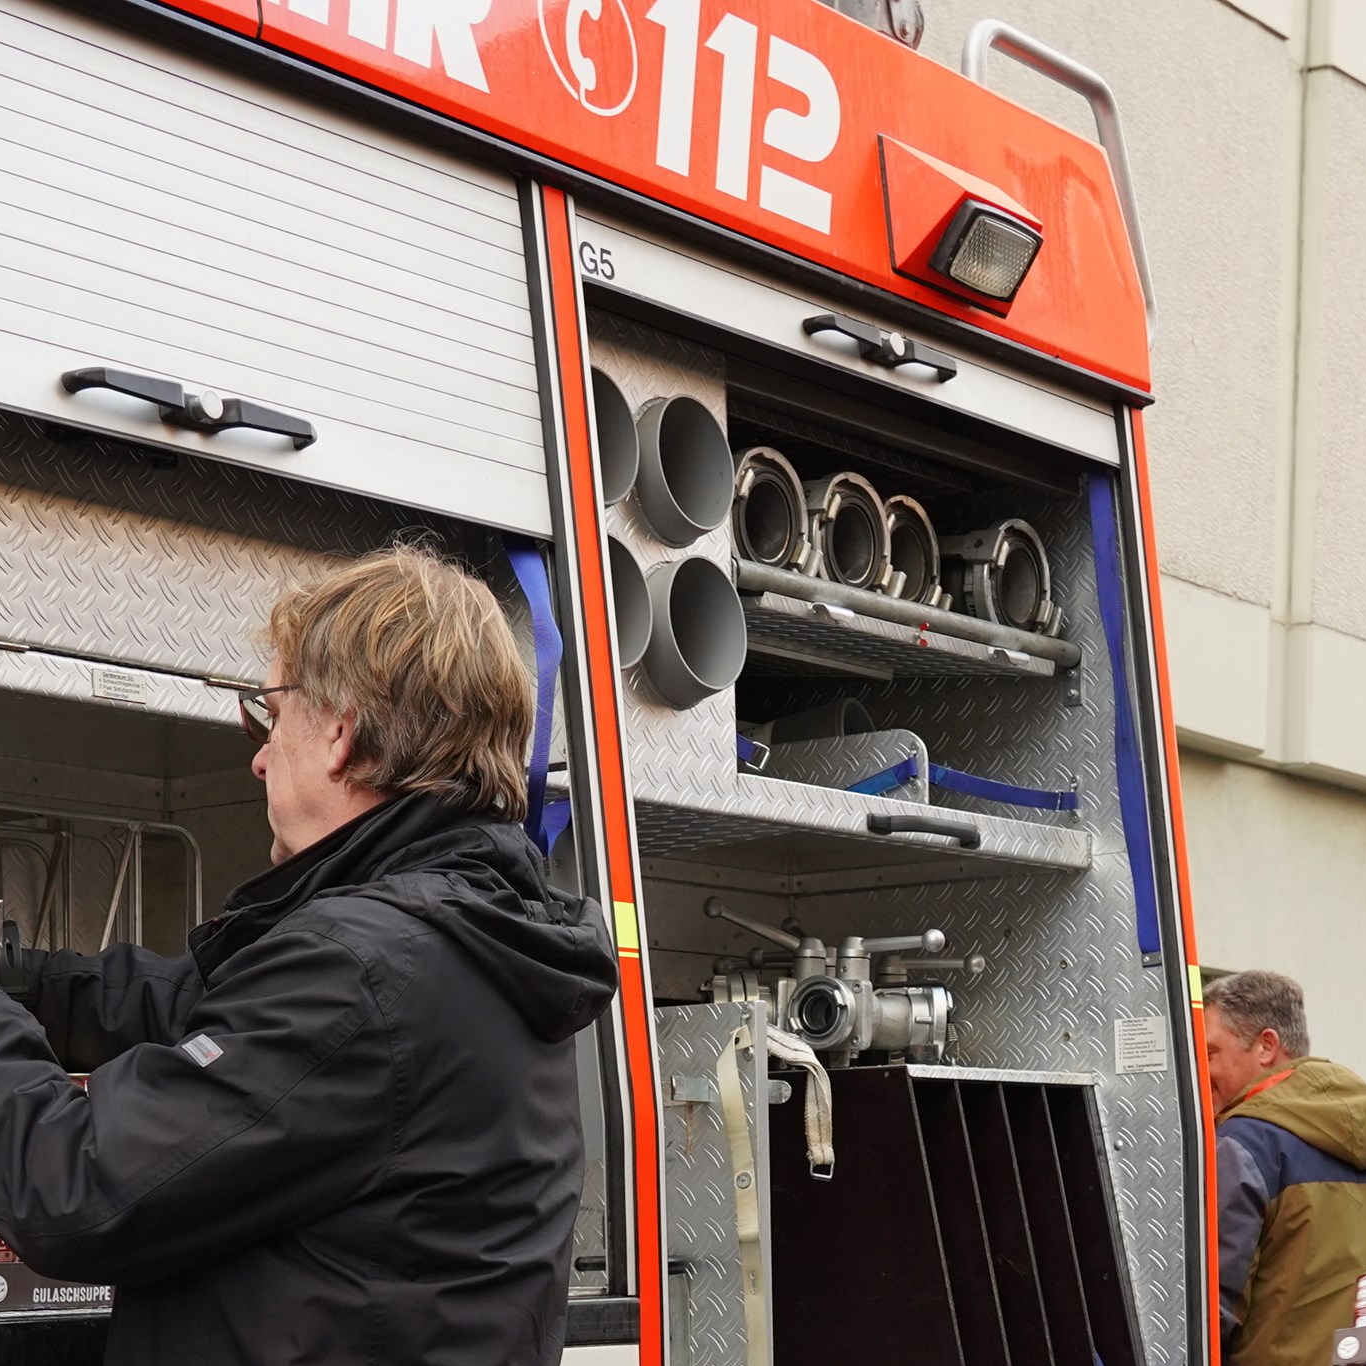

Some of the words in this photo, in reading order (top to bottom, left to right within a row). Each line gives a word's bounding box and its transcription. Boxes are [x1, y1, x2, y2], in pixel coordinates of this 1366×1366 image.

[645, 0, 841, 235] 112
[578, 241, 616, 280] G5
[33, 1286, 111, 1303] GULASCHSUPPE
